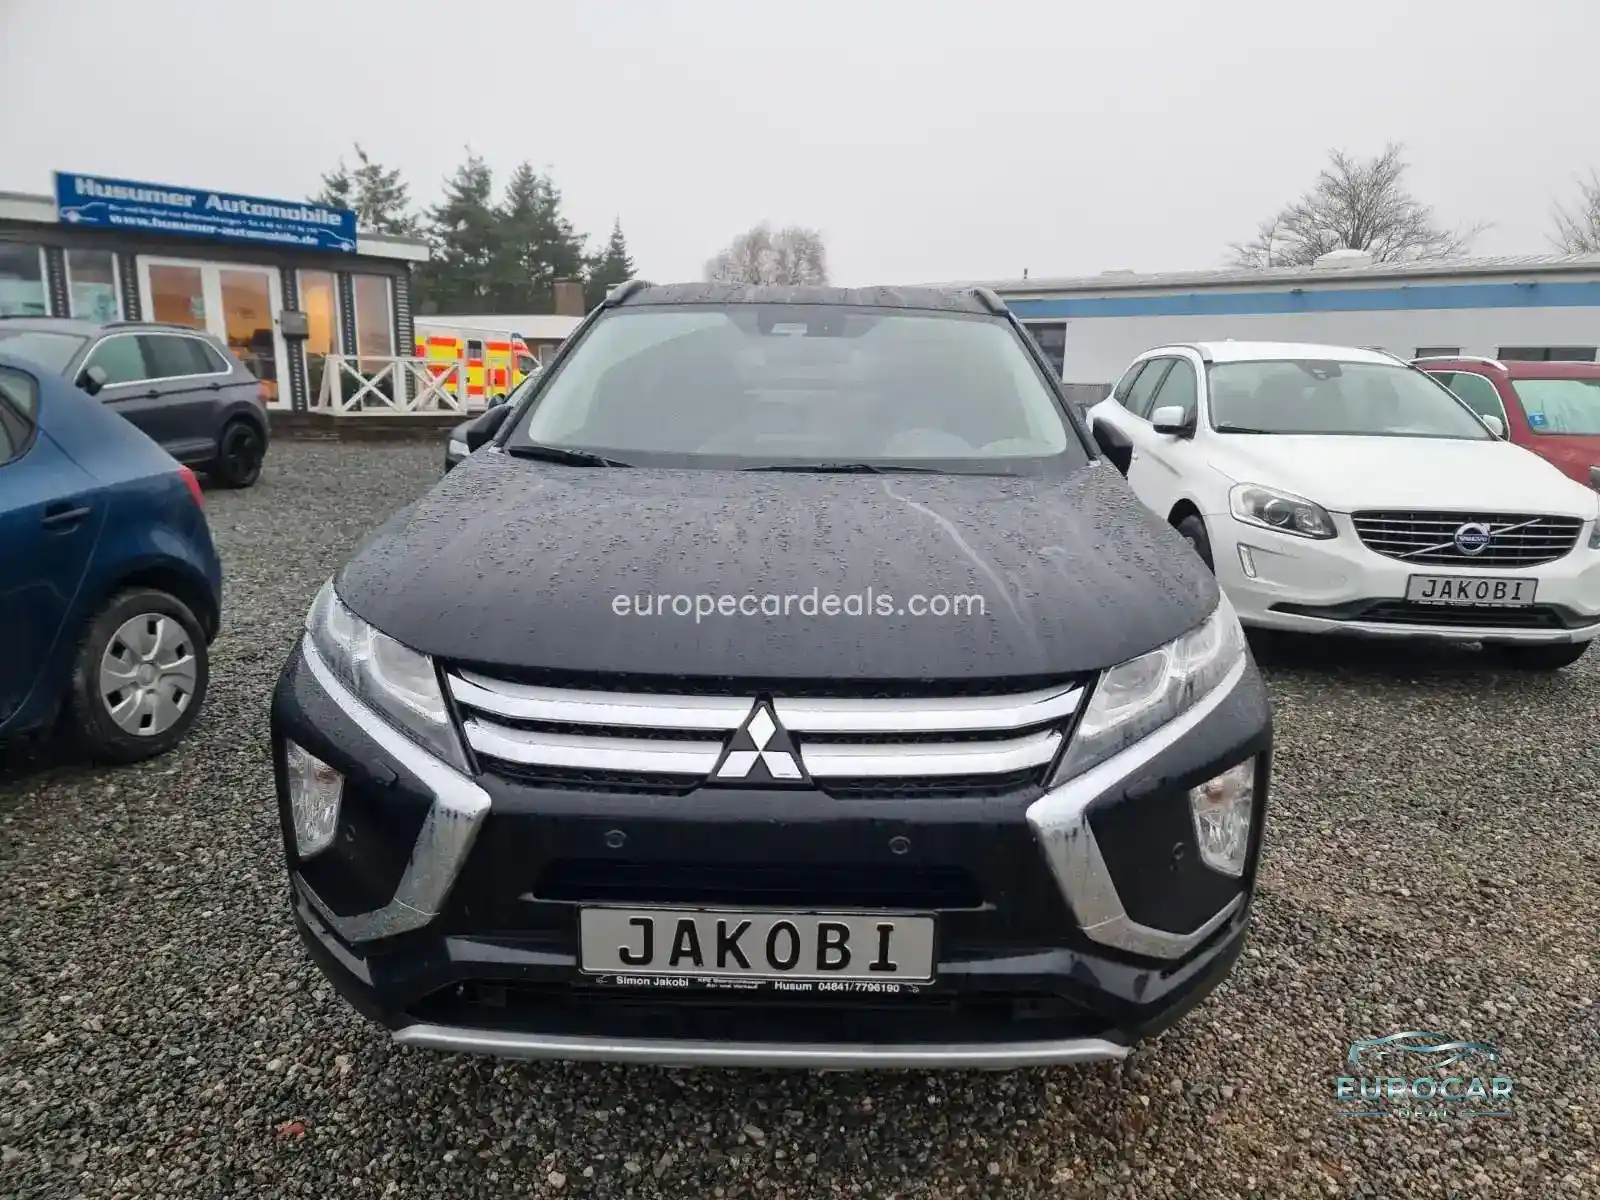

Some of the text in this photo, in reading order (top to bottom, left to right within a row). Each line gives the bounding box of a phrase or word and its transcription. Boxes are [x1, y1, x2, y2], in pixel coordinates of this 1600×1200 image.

[75, 177, 197, 208] Husumer
[205, 195, 343, 225] Automobile
[1421, 579, 1523, 600] JAKOBI
[618, 917, 898, 972] JAKOBI
[616, 976, 650, 986] Simon
[653, 977, 689, 987] Jakobi
[774, 981, 813, 991] Husum
